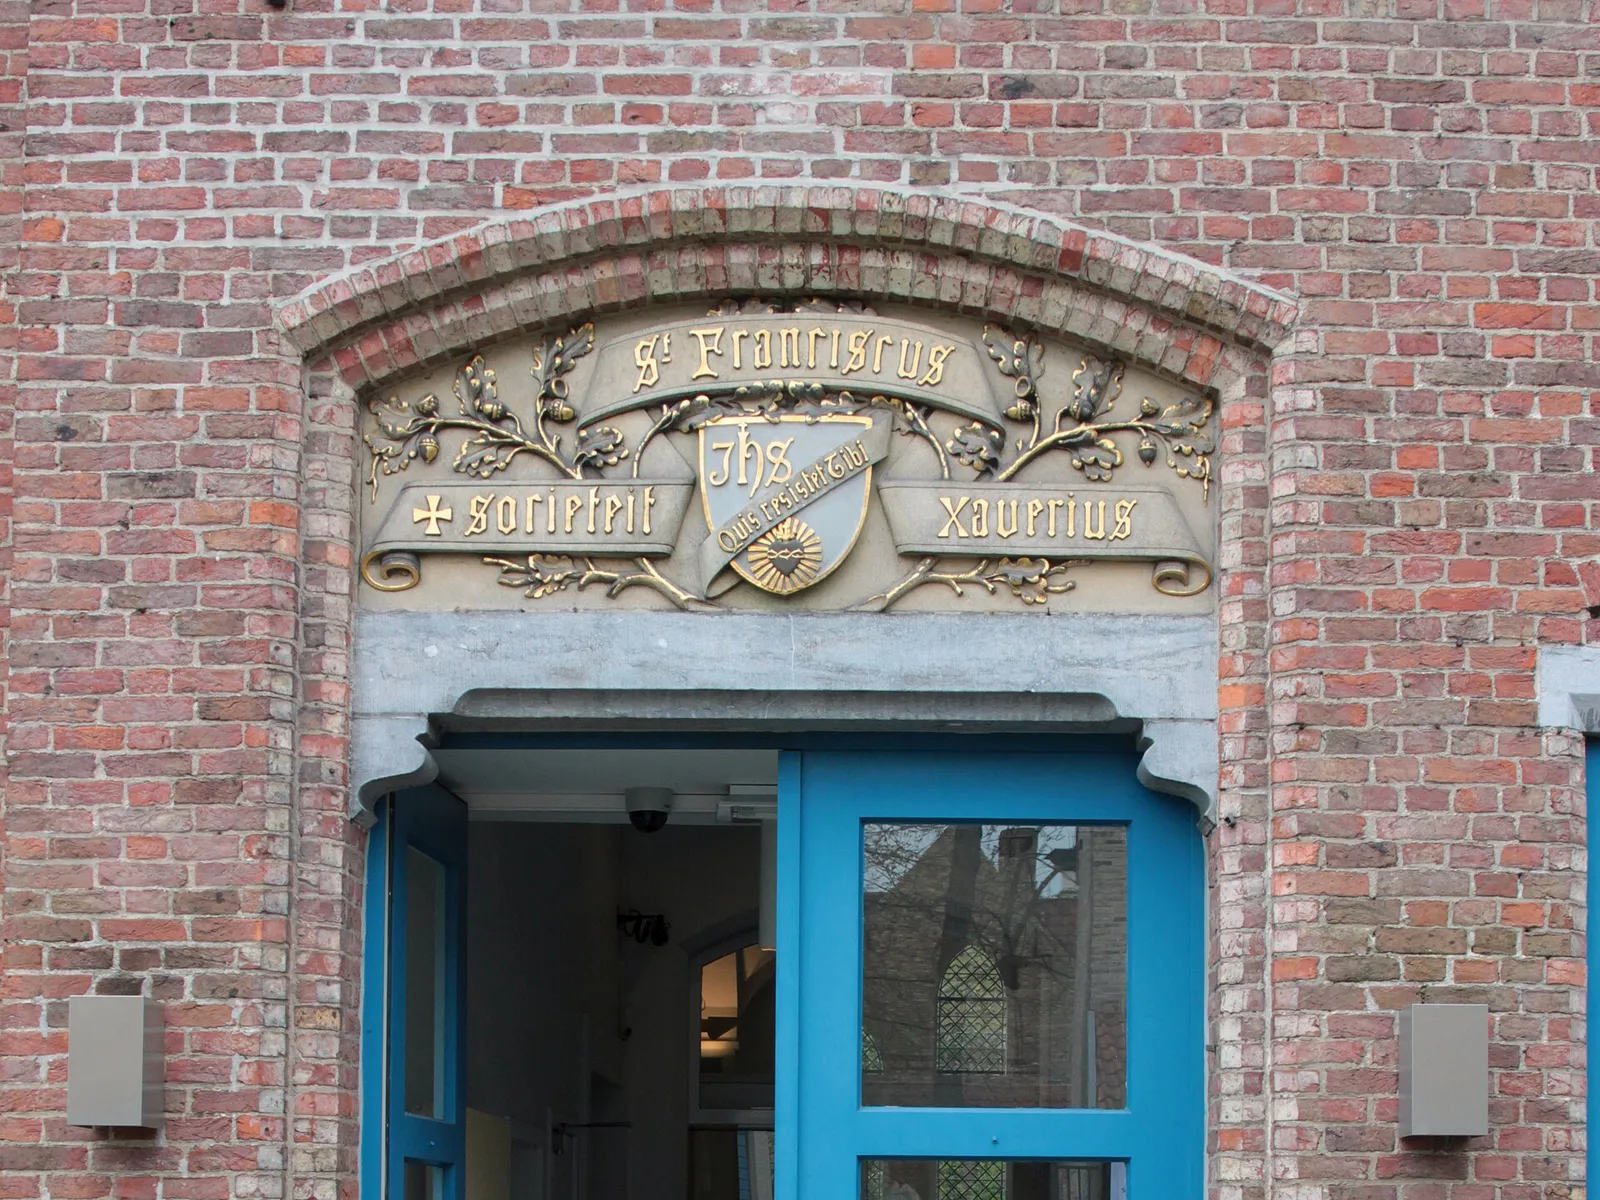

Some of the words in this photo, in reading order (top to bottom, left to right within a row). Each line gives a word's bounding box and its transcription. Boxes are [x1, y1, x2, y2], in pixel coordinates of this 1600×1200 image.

[689, 326, 955, 386] Franciscus
[718, 513, 762, 553] Quis
[937, 492, 1137, 541] Xaverius
